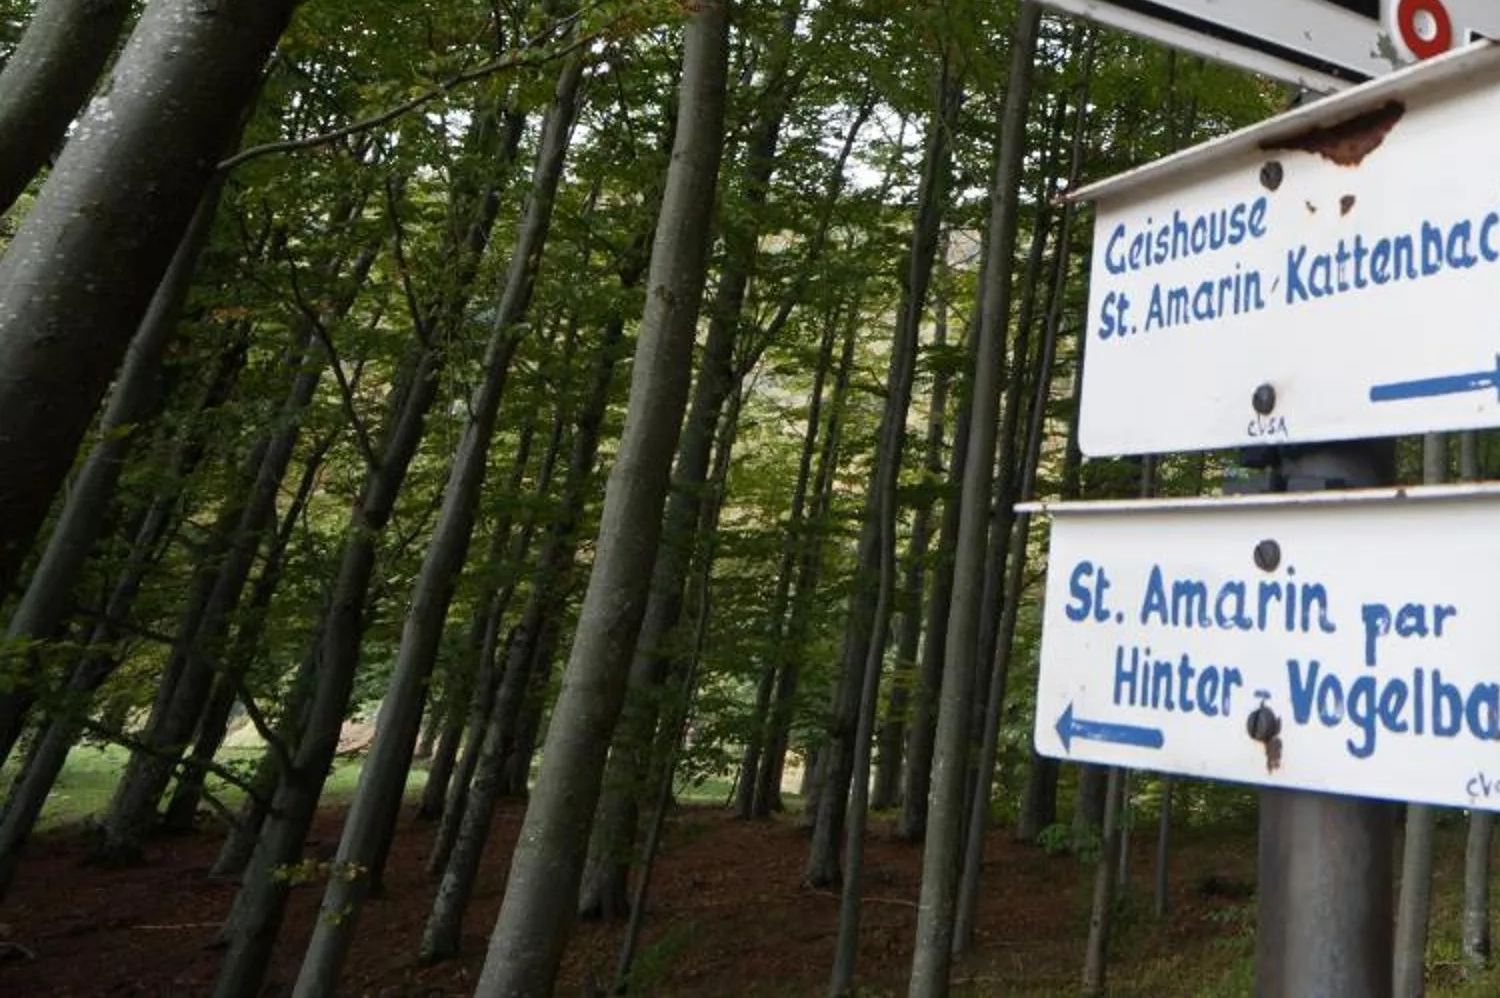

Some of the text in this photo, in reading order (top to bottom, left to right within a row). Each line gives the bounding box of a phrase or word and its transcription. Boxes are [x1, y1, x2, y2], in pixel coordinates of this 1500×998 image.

[1105, 196, 1268, 275] Geishouse
[1098, 290, 1138, 340] St.
[1144, 262, 1265, 332] Amarin
[1064, 560, 1458, 666] St. Amarin par
[1112, 645, 1243, 718] Hinter
